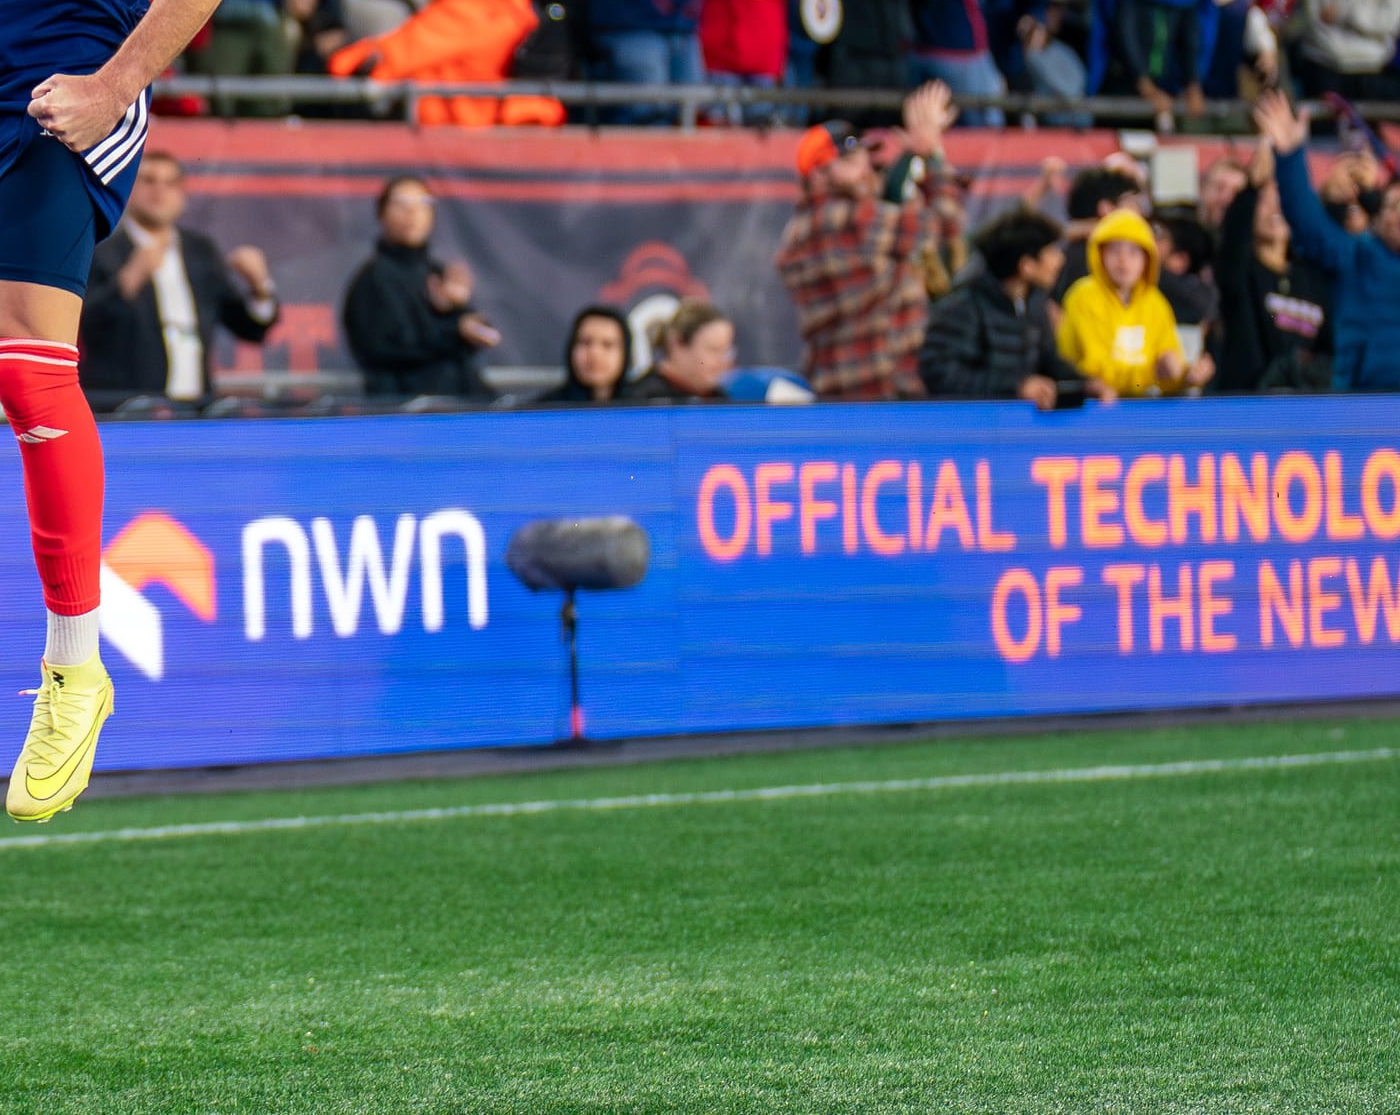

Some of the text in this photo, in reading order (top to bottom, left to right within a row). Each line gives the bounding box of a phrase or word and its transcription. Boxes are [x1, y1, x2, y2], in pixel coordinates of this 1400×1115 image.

[699, 448, 1400, 561] OFFICIAL TECHNOLO
[242, 508, 489, 640] nwn
[991, 555, 1400, 662] OF THE NEW
